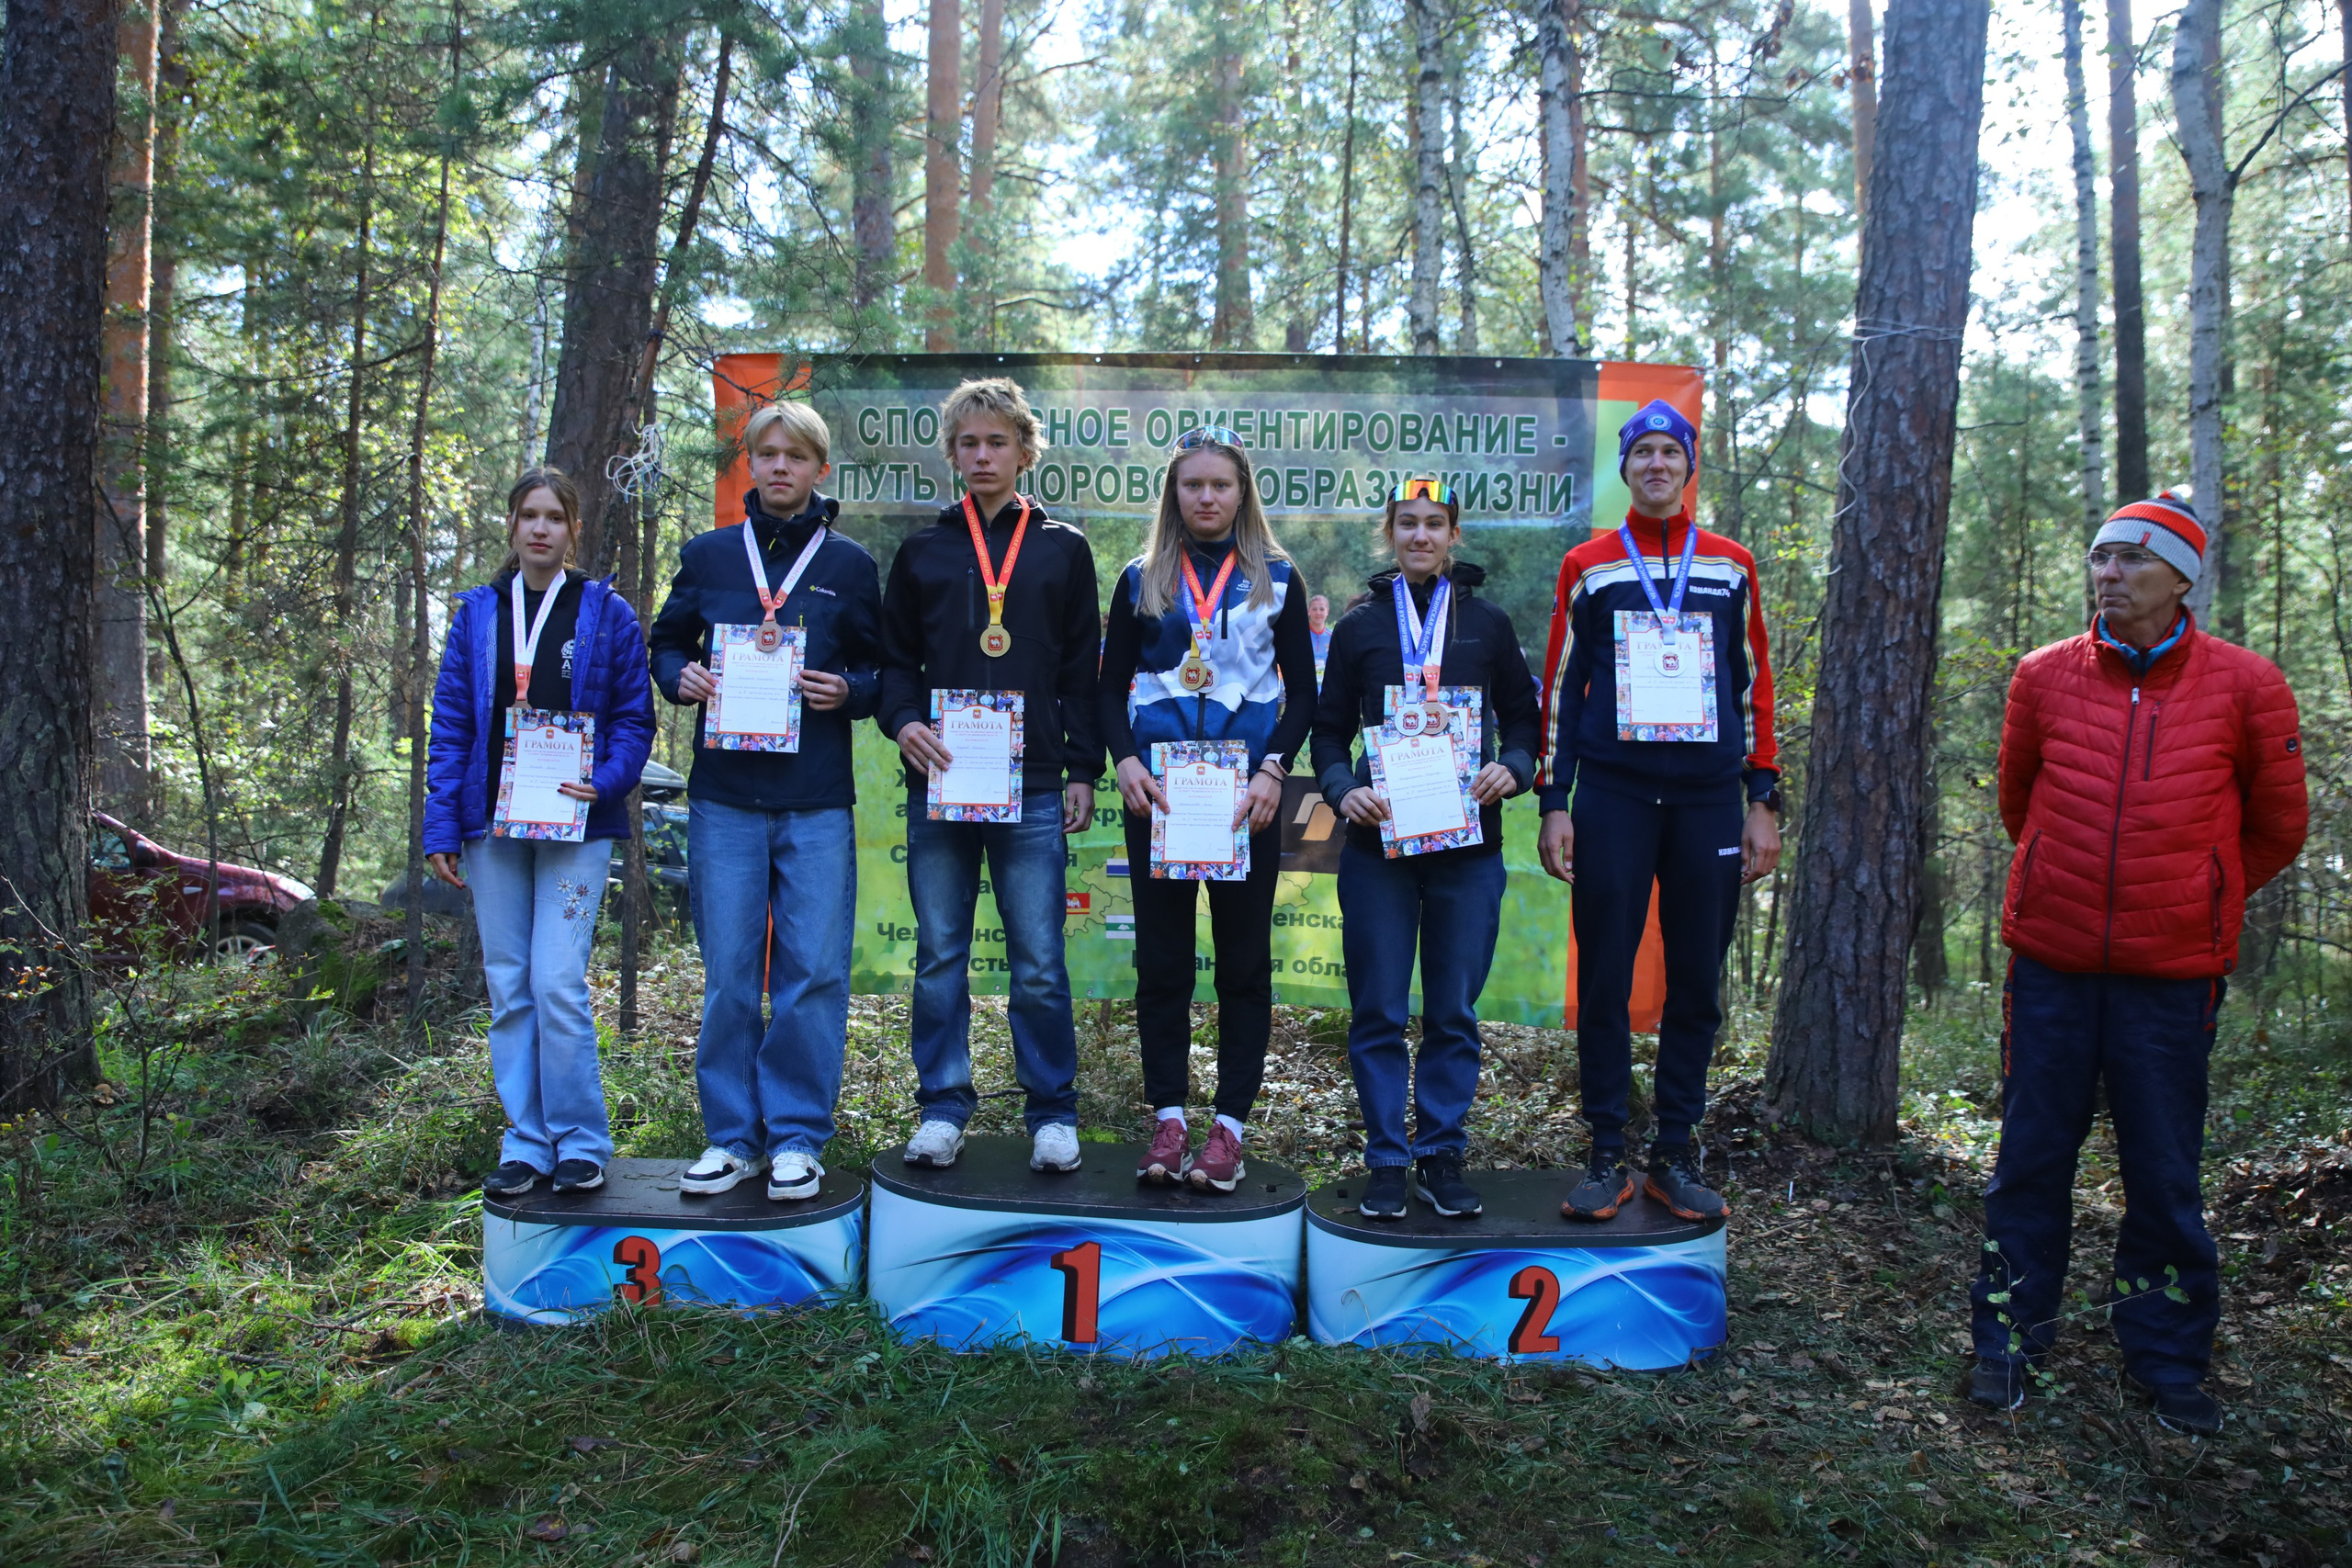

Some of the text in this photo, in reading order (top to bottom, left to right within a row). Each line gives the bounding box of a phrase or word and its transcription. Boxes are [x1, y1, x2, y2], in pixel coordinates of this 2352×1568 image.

[858, 406, 1130, 447] СПОНОЕ
[837, 462, 938, 502] ПУТЬ
[1429, 471, 1573, 514] ИЗНИ
[966, 505, 990, 575] ЧЕЛЯБИНСКАЯ ОБЛАСТЬ
[816, 586, 836, 596] Columbia
[1206, 581, 1222, 606] ОБЛАСТЬ
[1395, 583, 1403, 608] ОБЛАСТЬ
[1427, 584, 1444, 626] ЧЕЛЯБИНСКАЯ
[1398, 609, 1409, 653] ЧЕЛЯБИНСКАЯ
[1419, 626, 1431, 655] ОБЛАСТЬ
[732, 653, 784, 662] ГРАМОТА
[1636, 642, 1691, 650] ГРАТА
[951, 721, 1002, 729] ГРАМОТА
[525, 739, 574, 750] ГРАМОТА
[1390, 747, 1444, 762] ГРАМОТА
[1174, 777, 1227, 786] ГРАМОТА
[613, 1235, 662, 1307] 3
[1050, 1240, 1101, 1343] 1
[1508, 1265, 1560, 1353] 2
